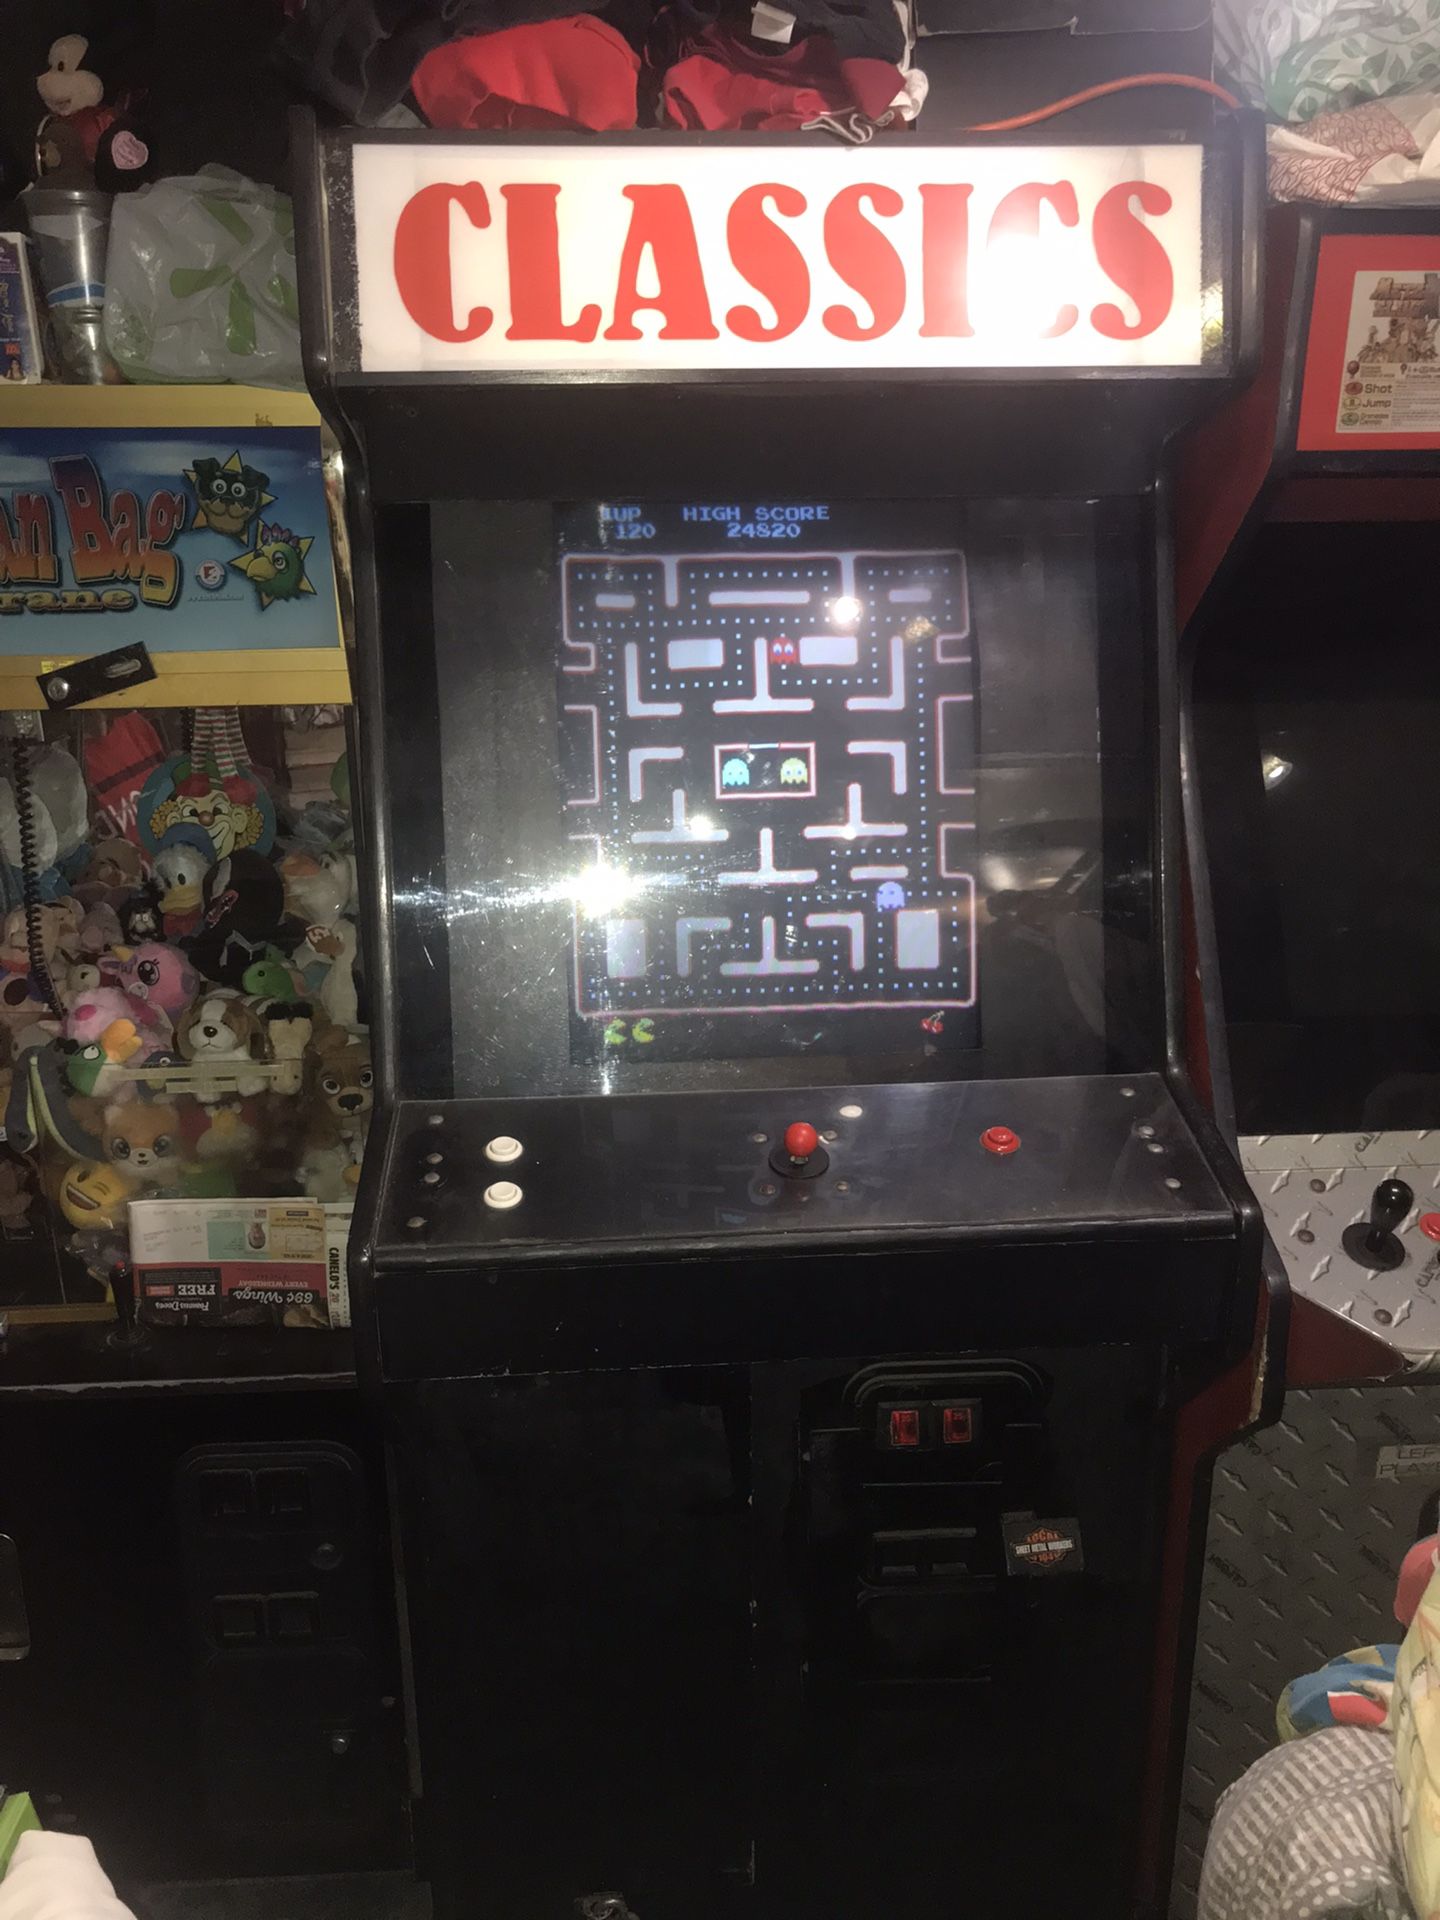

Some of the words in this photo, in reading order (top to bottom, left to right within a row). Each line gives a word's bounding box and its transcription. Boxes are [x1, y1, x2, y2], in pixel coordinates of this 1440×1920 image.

[682, 506, 741, 522] HIGH
[754, 505, 830, 521] SCORE
[48, 453, 186, 608] Bag
[614, 523, 656, 540] 120
[726, 522, 801, 539] 24820
[177, 1284, 216, 1296] FREE
[232, 1286, 284, 1304] Wings
[286, 1291, 314, 1304] 69¢
